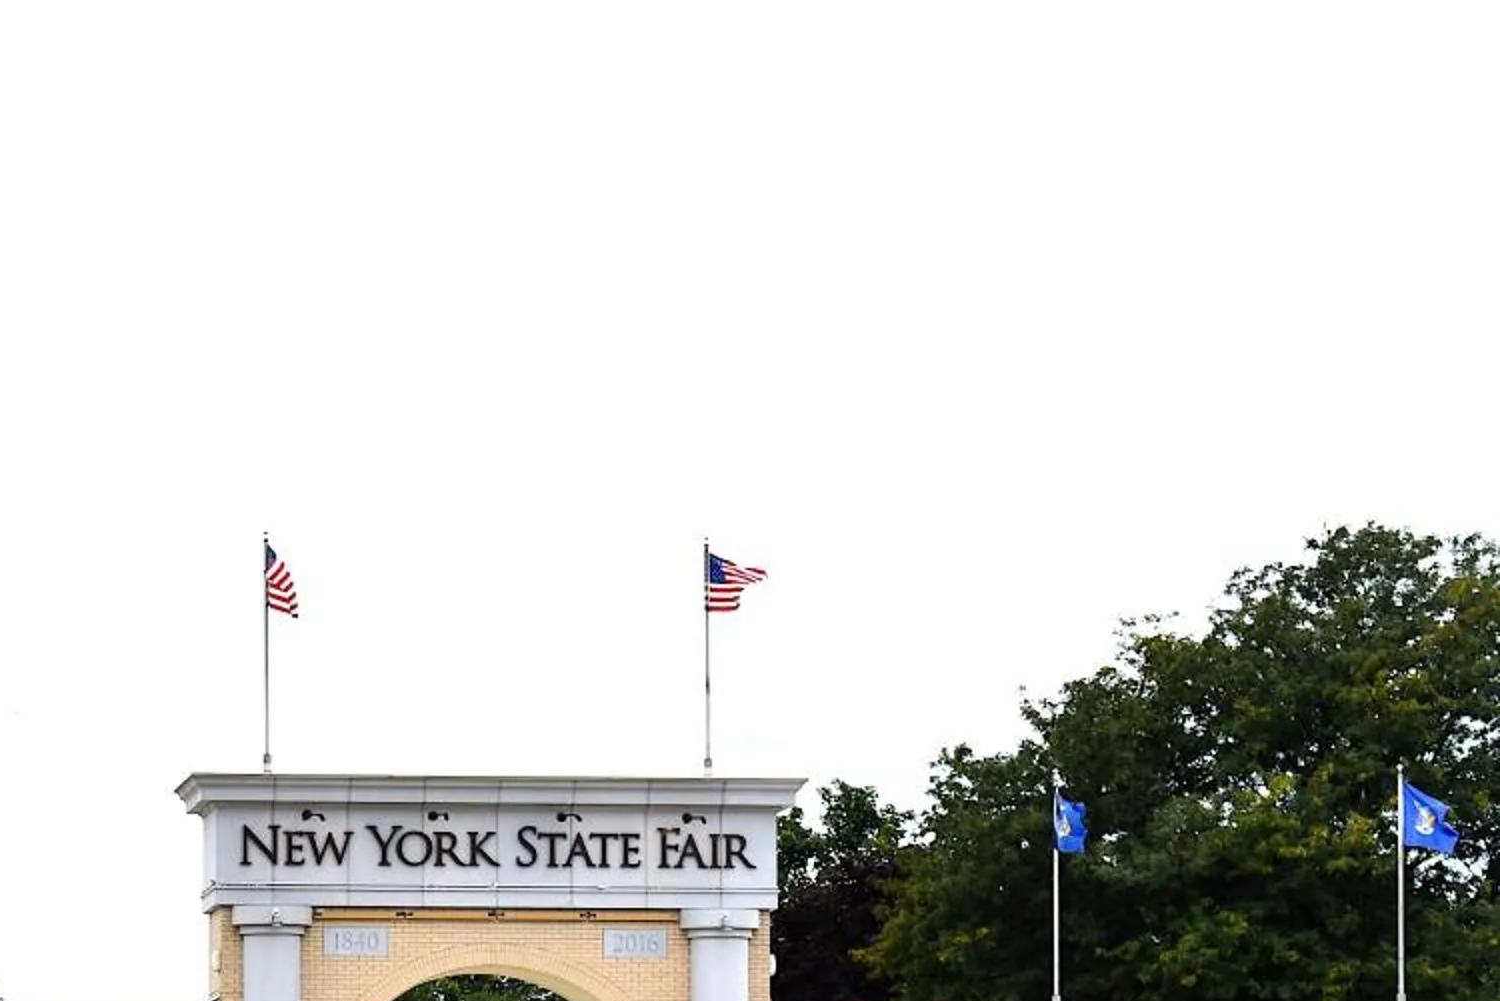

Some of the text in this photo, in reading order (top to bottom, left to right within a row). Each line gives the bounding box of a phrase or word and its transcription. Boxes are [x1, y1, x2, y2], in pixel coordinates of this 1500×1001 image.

[239, 824, 757, 870] NEW YORK STATE FAIR
[334, 931, 380, 952] 1840
[612, 932, 660, 953] 2016
